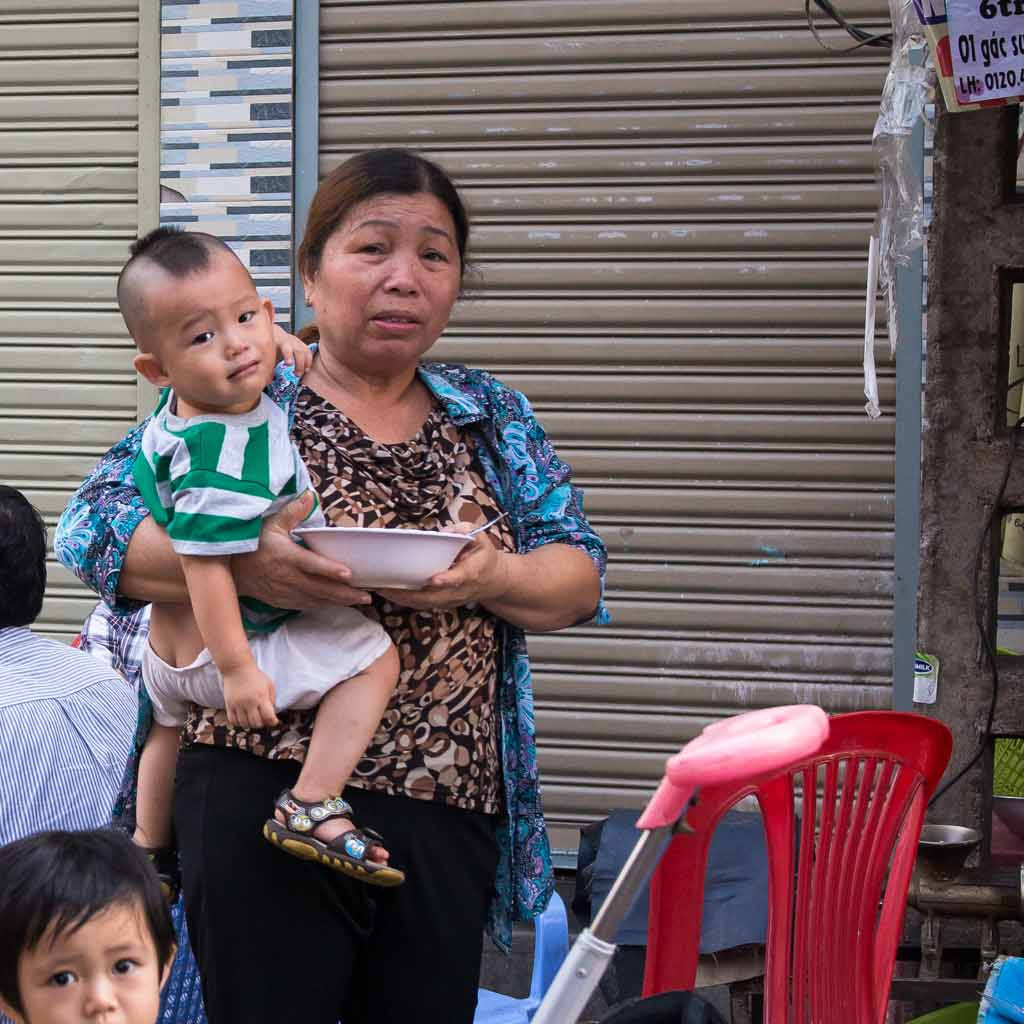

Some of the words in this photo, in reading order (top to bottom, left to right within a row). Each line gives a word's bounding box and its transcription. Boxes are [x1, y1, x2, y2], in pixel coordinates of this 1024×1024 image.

[958, 34, 976, 63] 01
[981, 31, 1007, 67] gác
[959, 75, 981, 94] LH:
